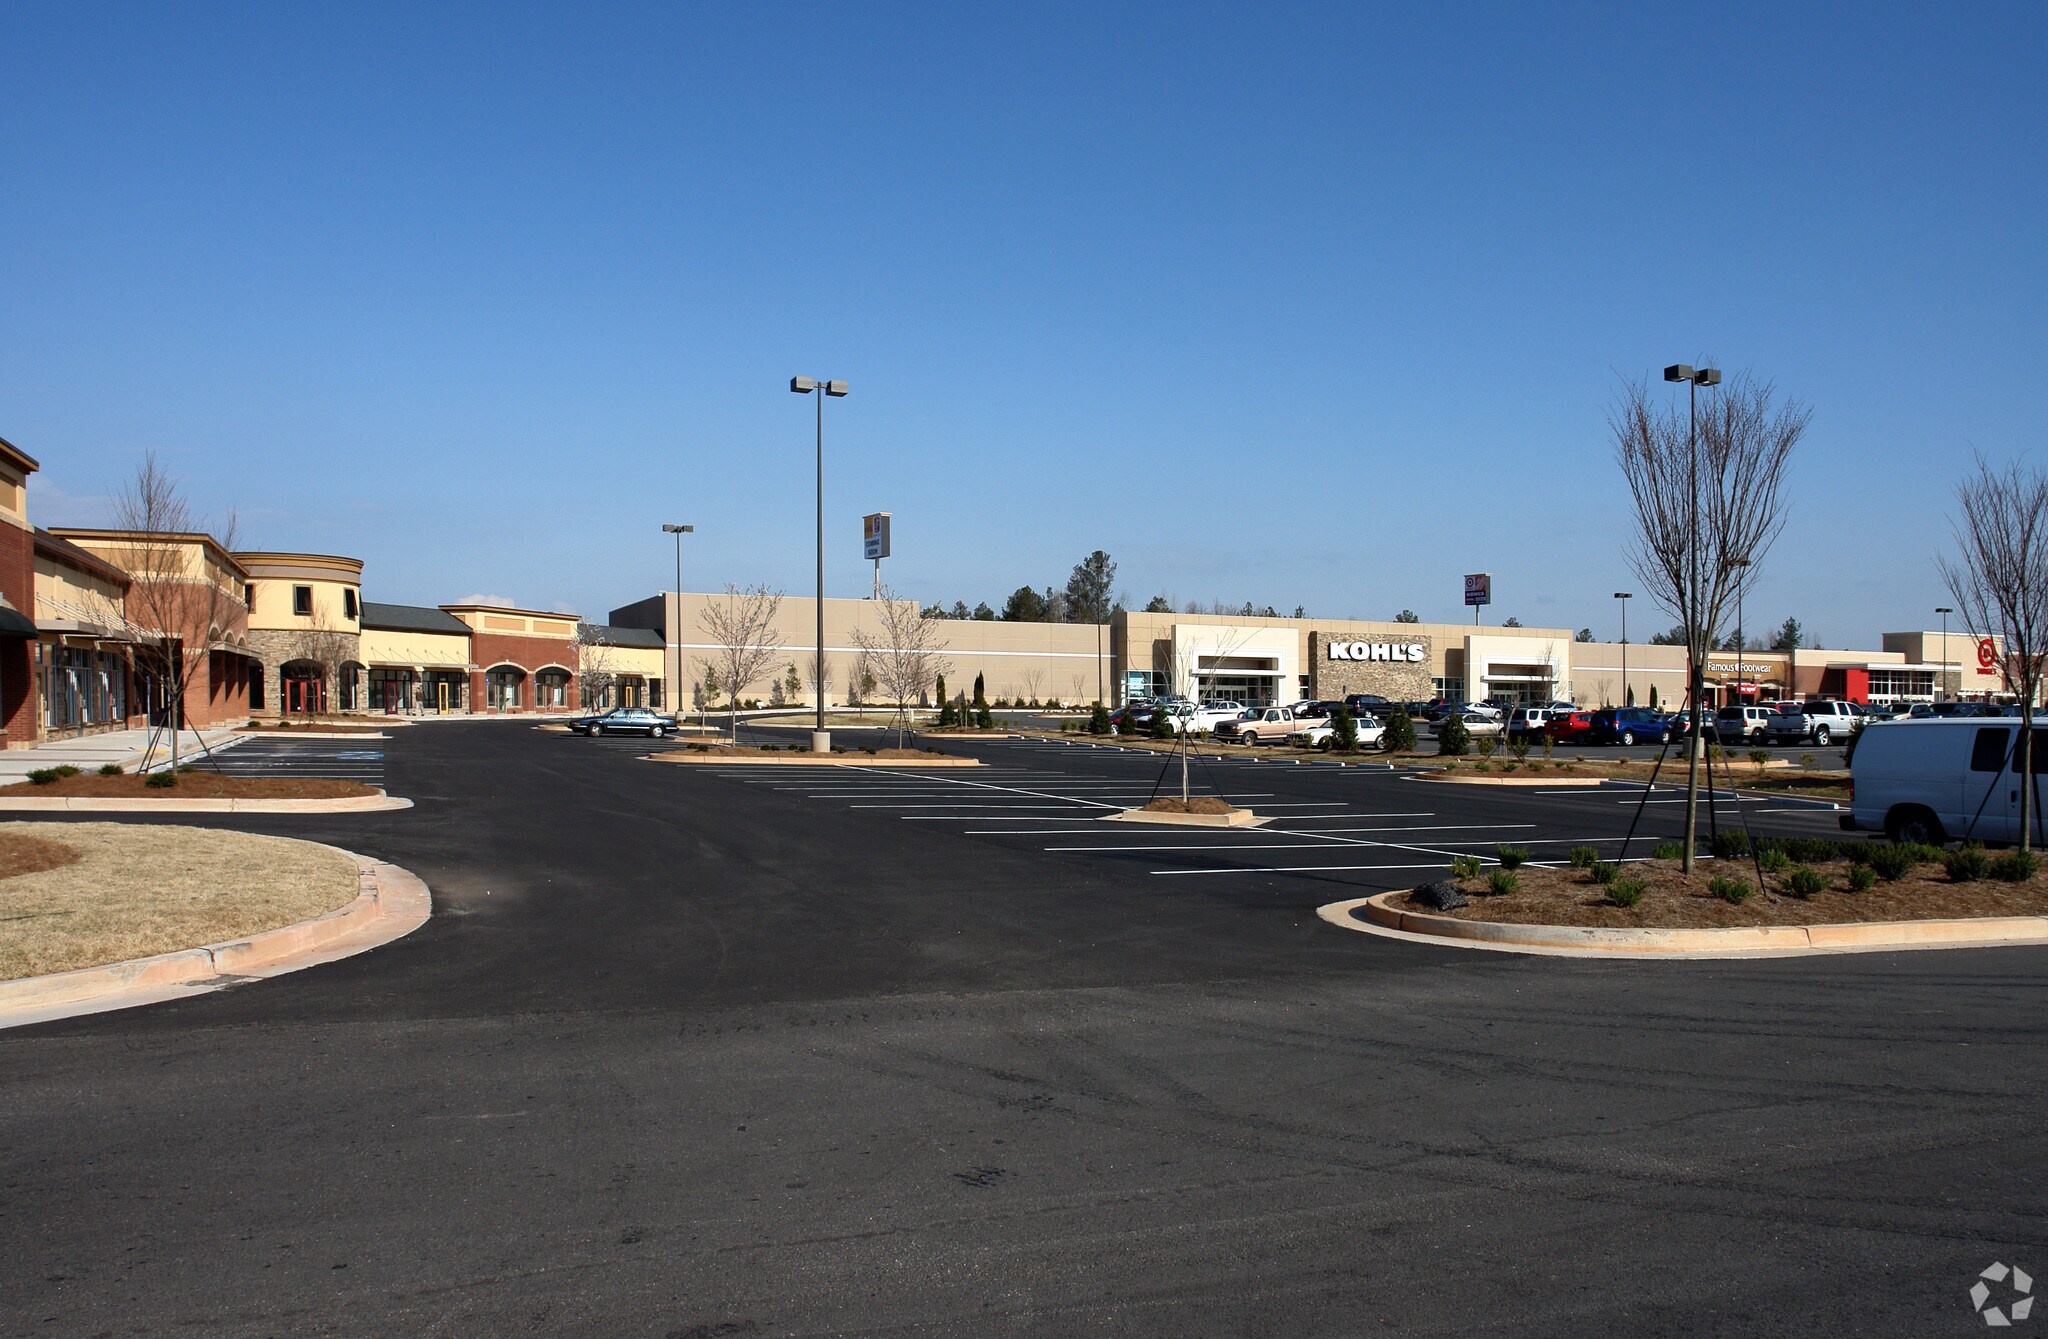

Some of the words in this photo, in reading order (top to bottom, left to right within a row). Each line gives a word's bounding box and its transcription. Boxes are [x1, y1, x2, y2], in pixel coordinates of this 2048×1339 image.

[1328, 641, 1425, 662] KOHL'S
[1707, 661, 1735, 672] Famous
[1740, 663, 1772, 672] Footwear
